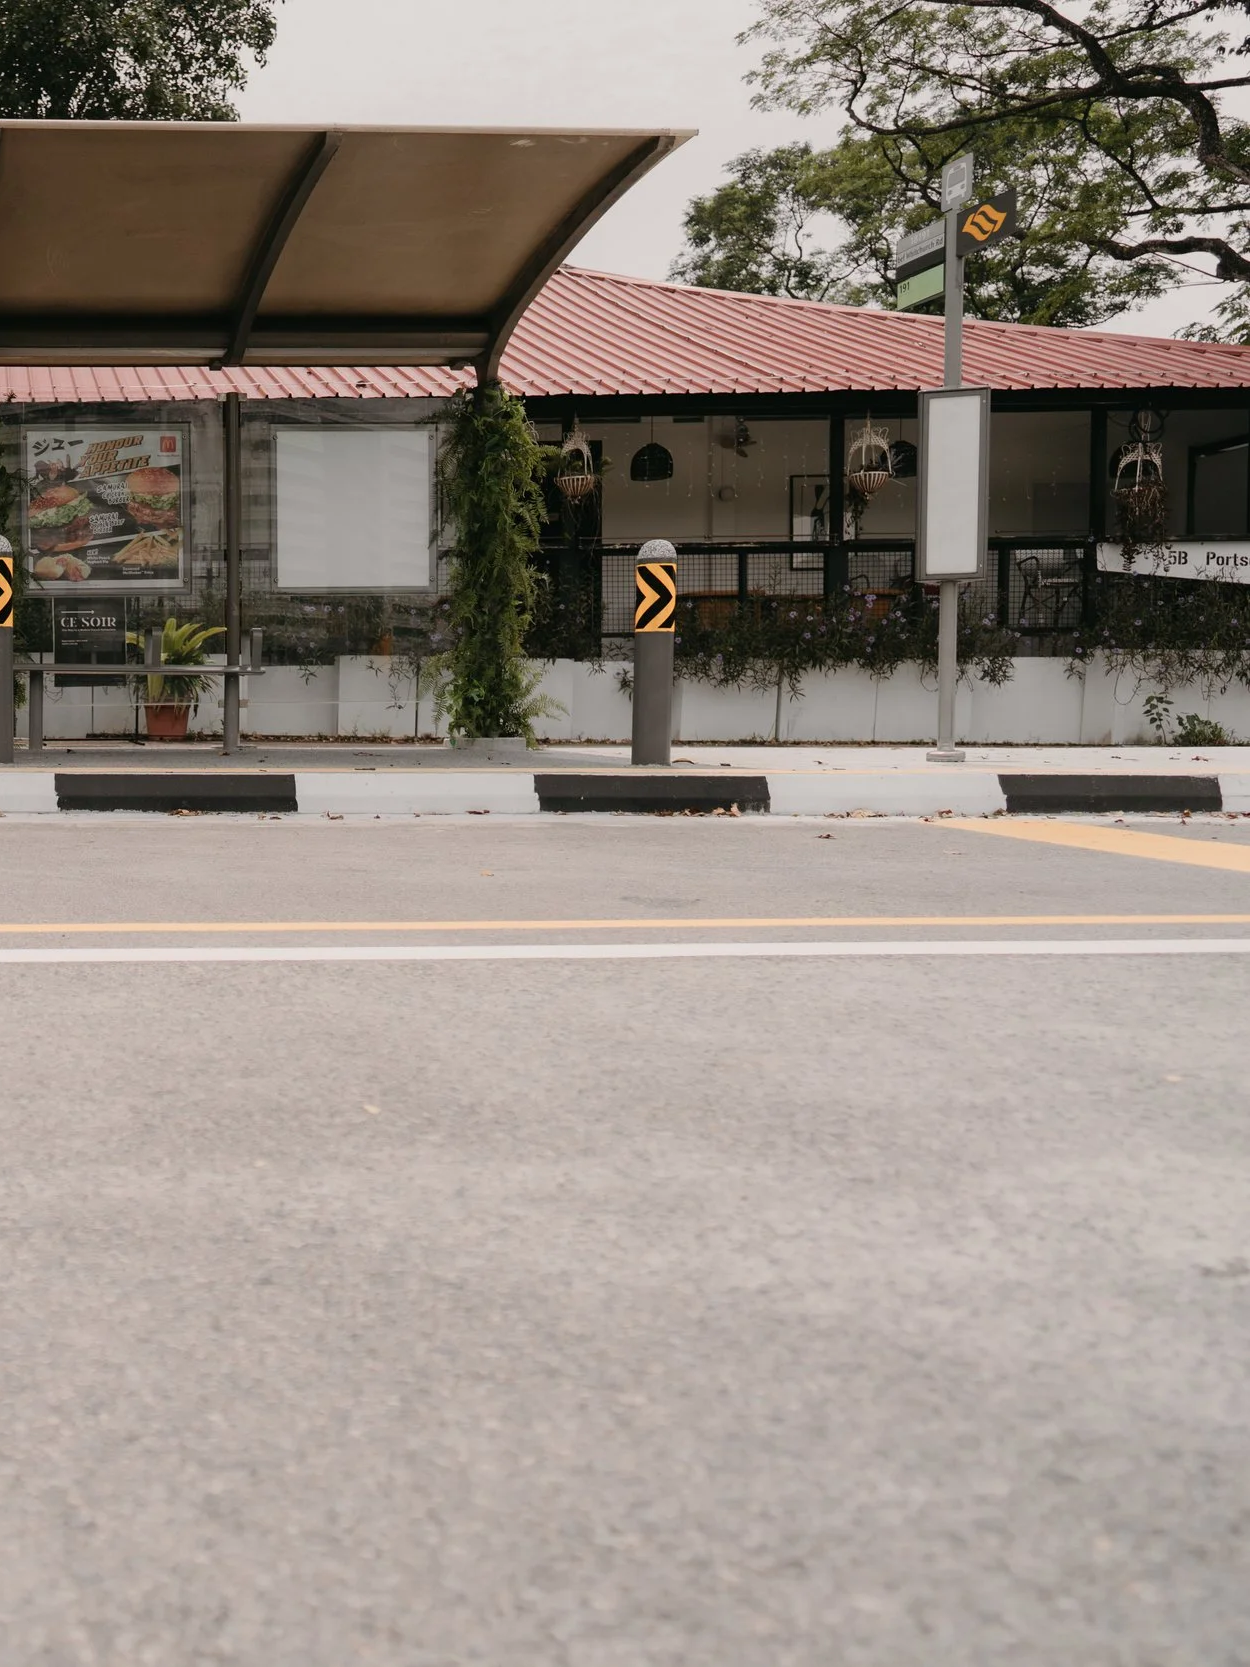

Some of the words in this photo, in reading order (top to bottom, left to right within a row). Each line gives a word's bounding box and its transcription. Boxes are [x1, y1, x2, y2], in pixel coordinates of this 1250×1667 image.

[935, 236, 944, 247] Rd
[899, 281, 910, 294] 191
[86, 434, 144, 455] HONOUR
[79, 448, 119, 468] YOUR
[79, 454, 151, 479] APPETITE
[96, 481, 128, 494] SAMURAI
[107, 495, 130, 505] BURGER
[89, 512, 119, 523] SAMURAI
[1168, 550, 1189, 565] 5B
[1206, 551, 1250, 567] Ports
[60, 617, 77, 628] CE
[81, 616, 117, 627] SOIR
